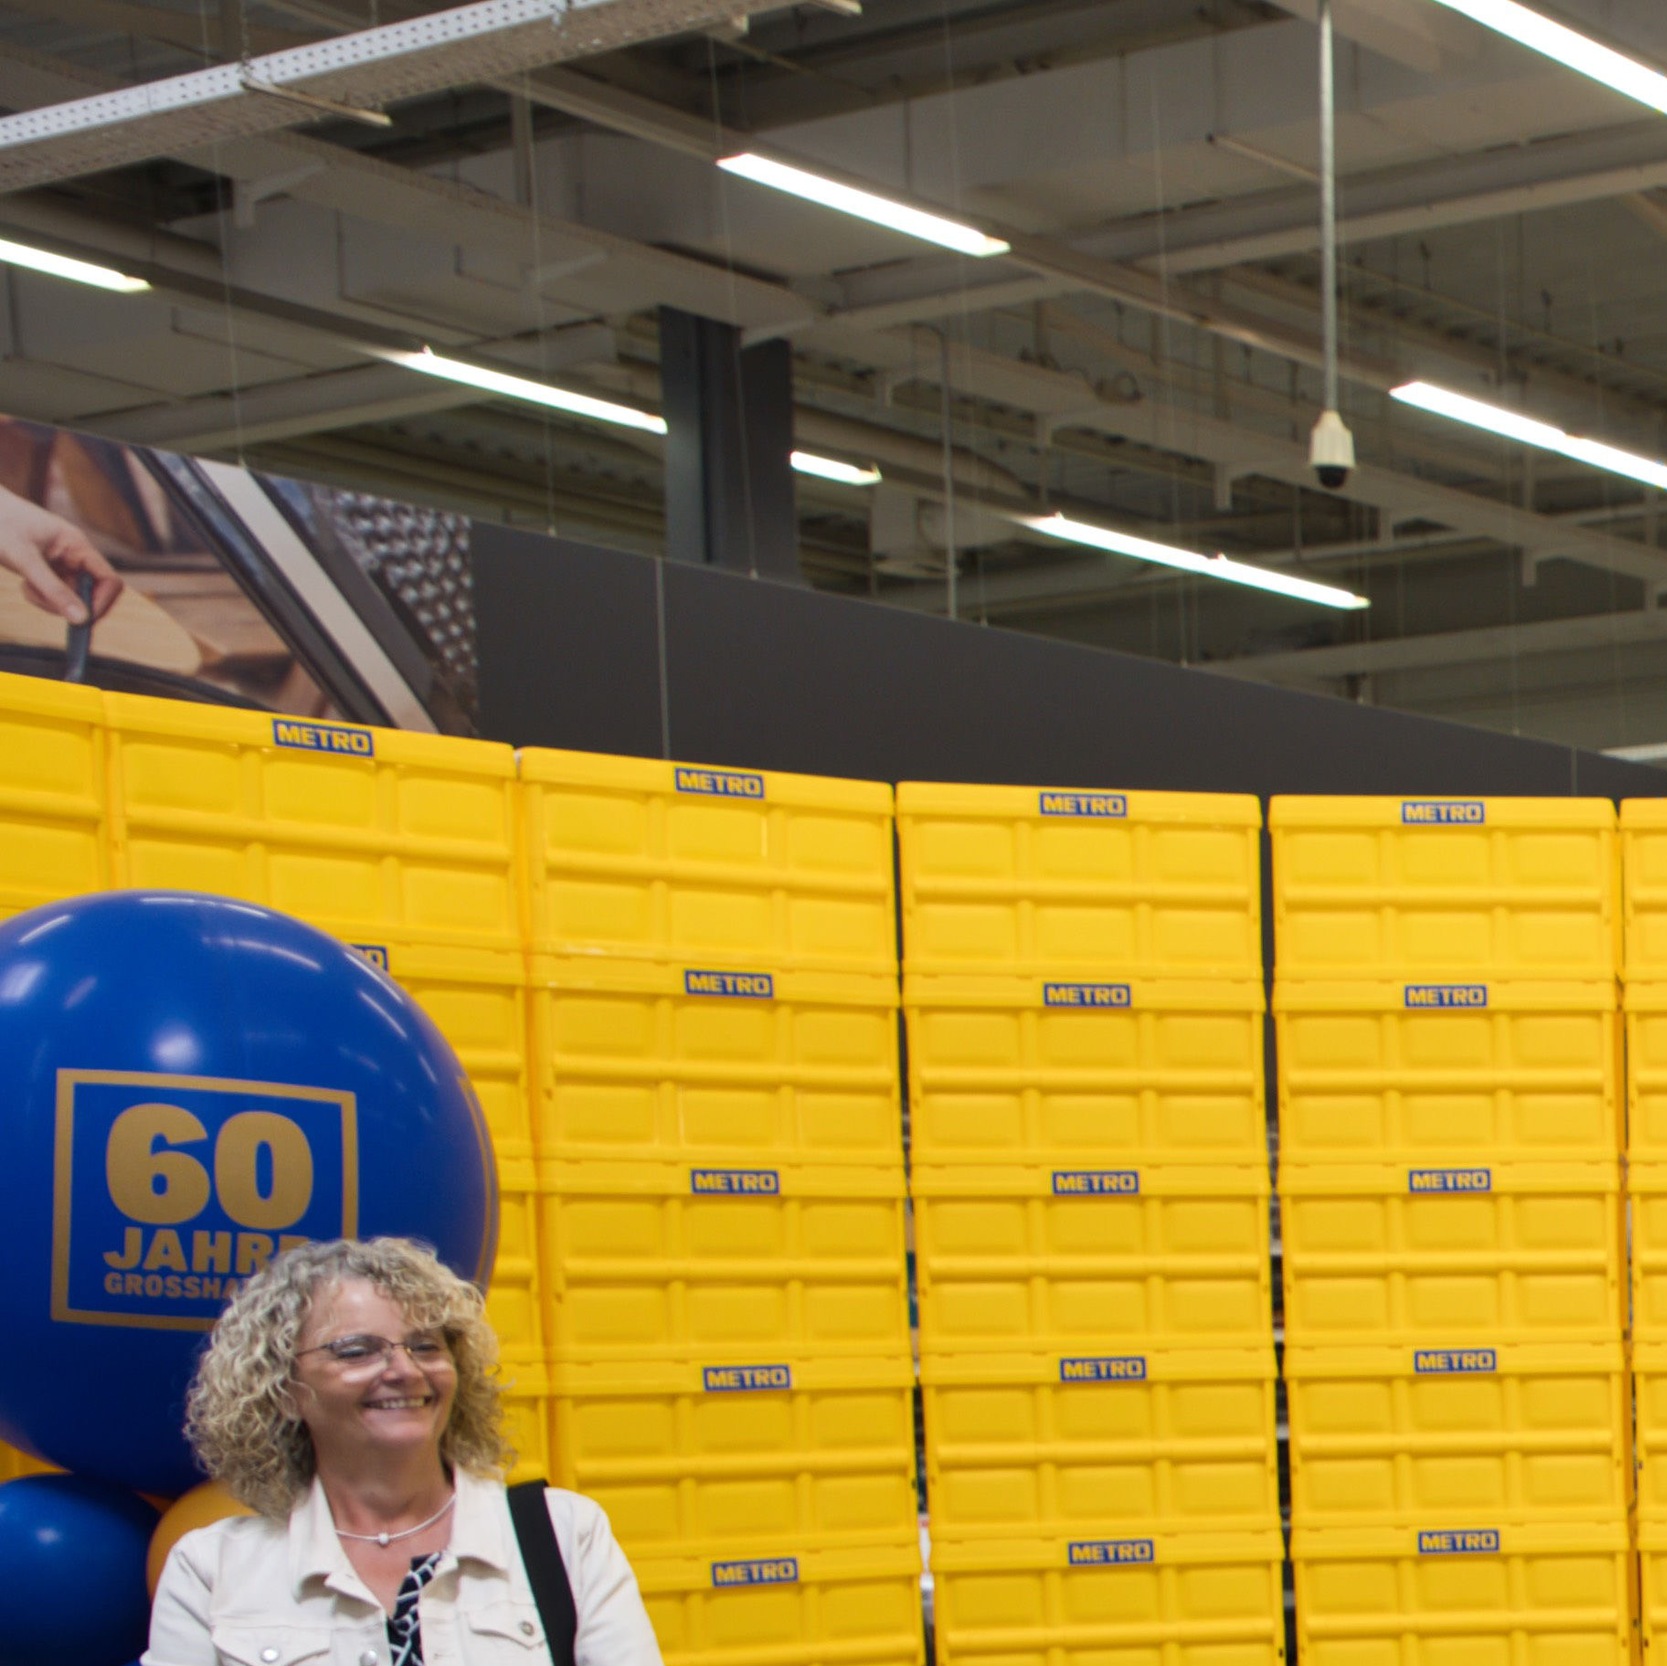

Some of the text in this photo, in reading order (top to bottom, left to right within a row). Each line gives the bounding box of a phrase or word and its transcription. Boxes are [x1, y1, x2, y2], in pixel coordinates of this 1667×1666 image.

[277, 723, 371, 752] METRO
[678, 771, 762, 794] METRO
[1042, 796, 1125, 813] METRO
[1405, 805, 1481, 821] METRO
[688, 974, 770, 994] METRO
[1047, 987, 1128, 1003] METRO
[1408, 989, 1484, 1004] METRO
[105, 1102, 314, 1230] 60
[695, 1174, 776, 1191] METRO
[1056, 1175, 1136, 1191] METRO
[1412, 1173, 1488, 1188] METRO
[102, 1226, 310, 1274] JAHR
[103, 1273, 243, 1300] GROSSHA
[1063, 1361, 1143, 1377] METRO
[1417, 1353, 1493, 1369] METRO
[707, 1369, 787, 1387] METRO
[1421, 1533, 1496, 1550] METRO
[1071, 1544, 1151, 1561] METRO
[715, 1562, 795, 1582] METRO
